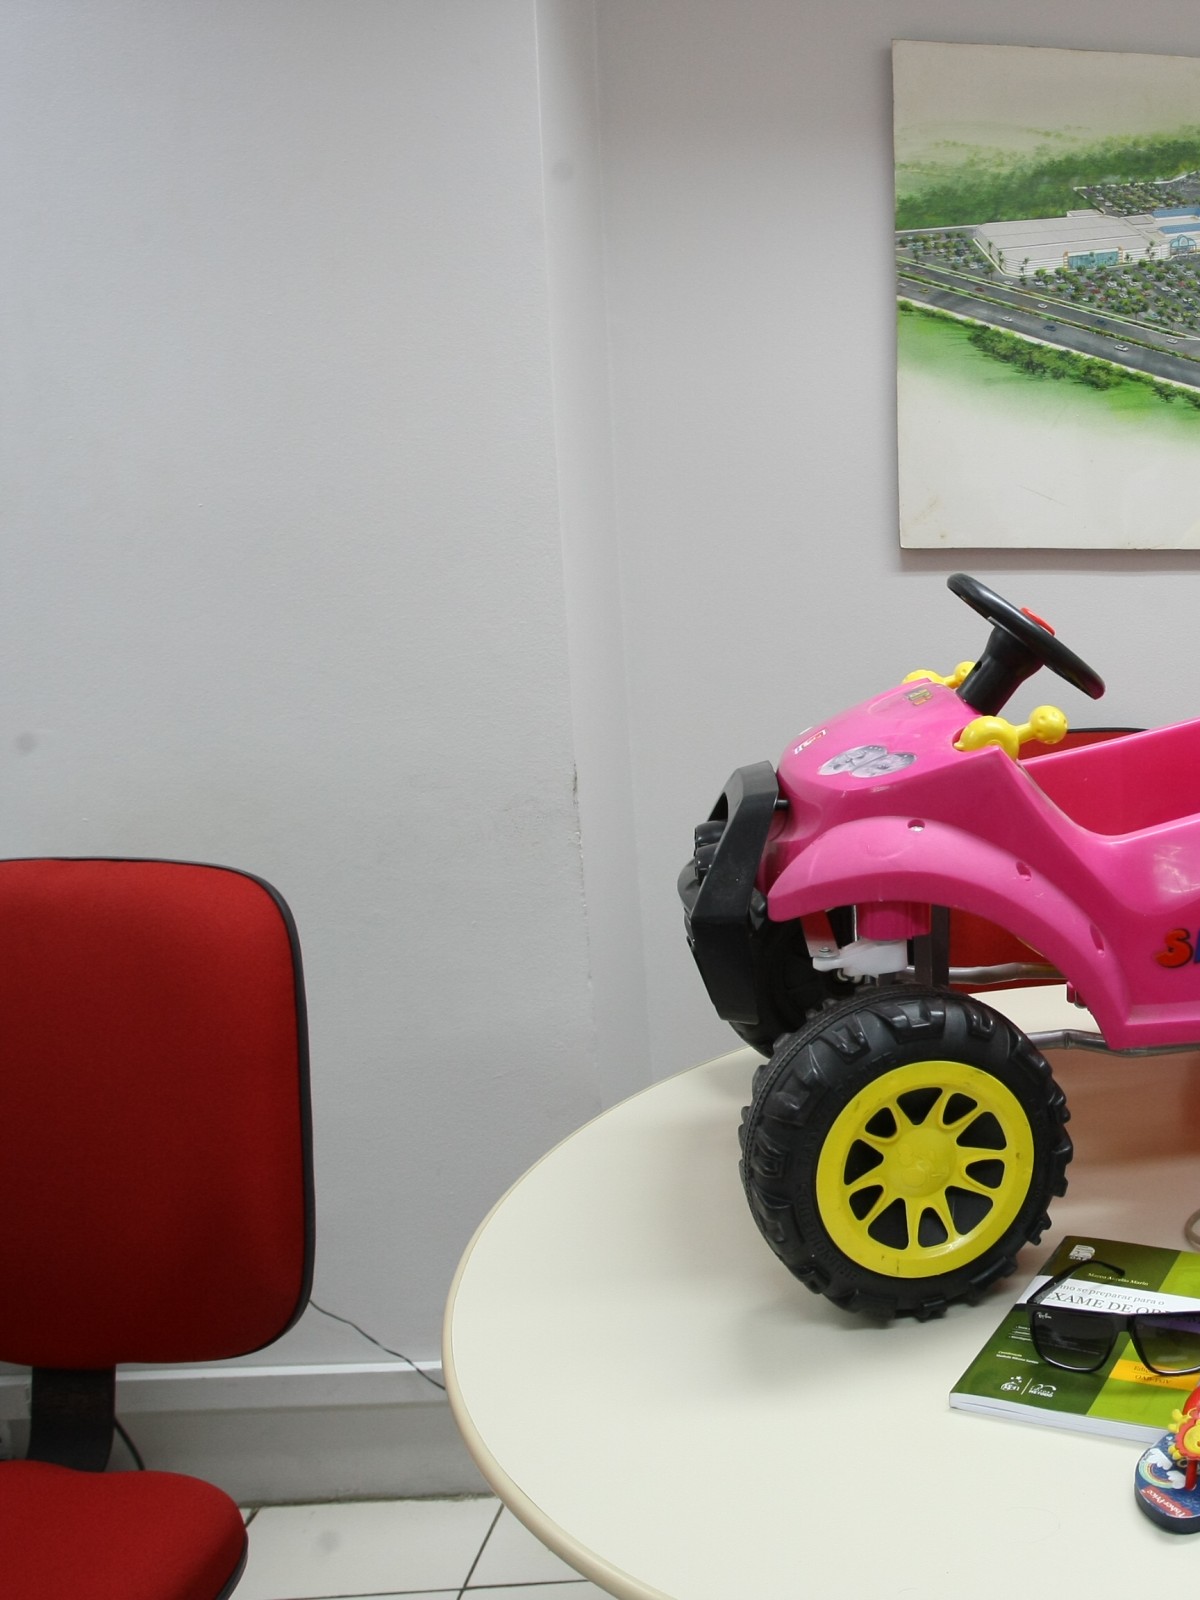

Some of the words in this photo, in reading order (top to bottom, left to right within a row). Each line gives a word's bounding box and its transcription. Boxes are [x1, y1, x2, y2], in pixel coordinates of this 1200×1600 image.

[1047, 1292, 1105, 1309] XAME
[1107, 1300, 1133, 1314] DE
[1088, 1289, 1133, 1300] preparar
[1133, 1296, 1156, 1305] para
